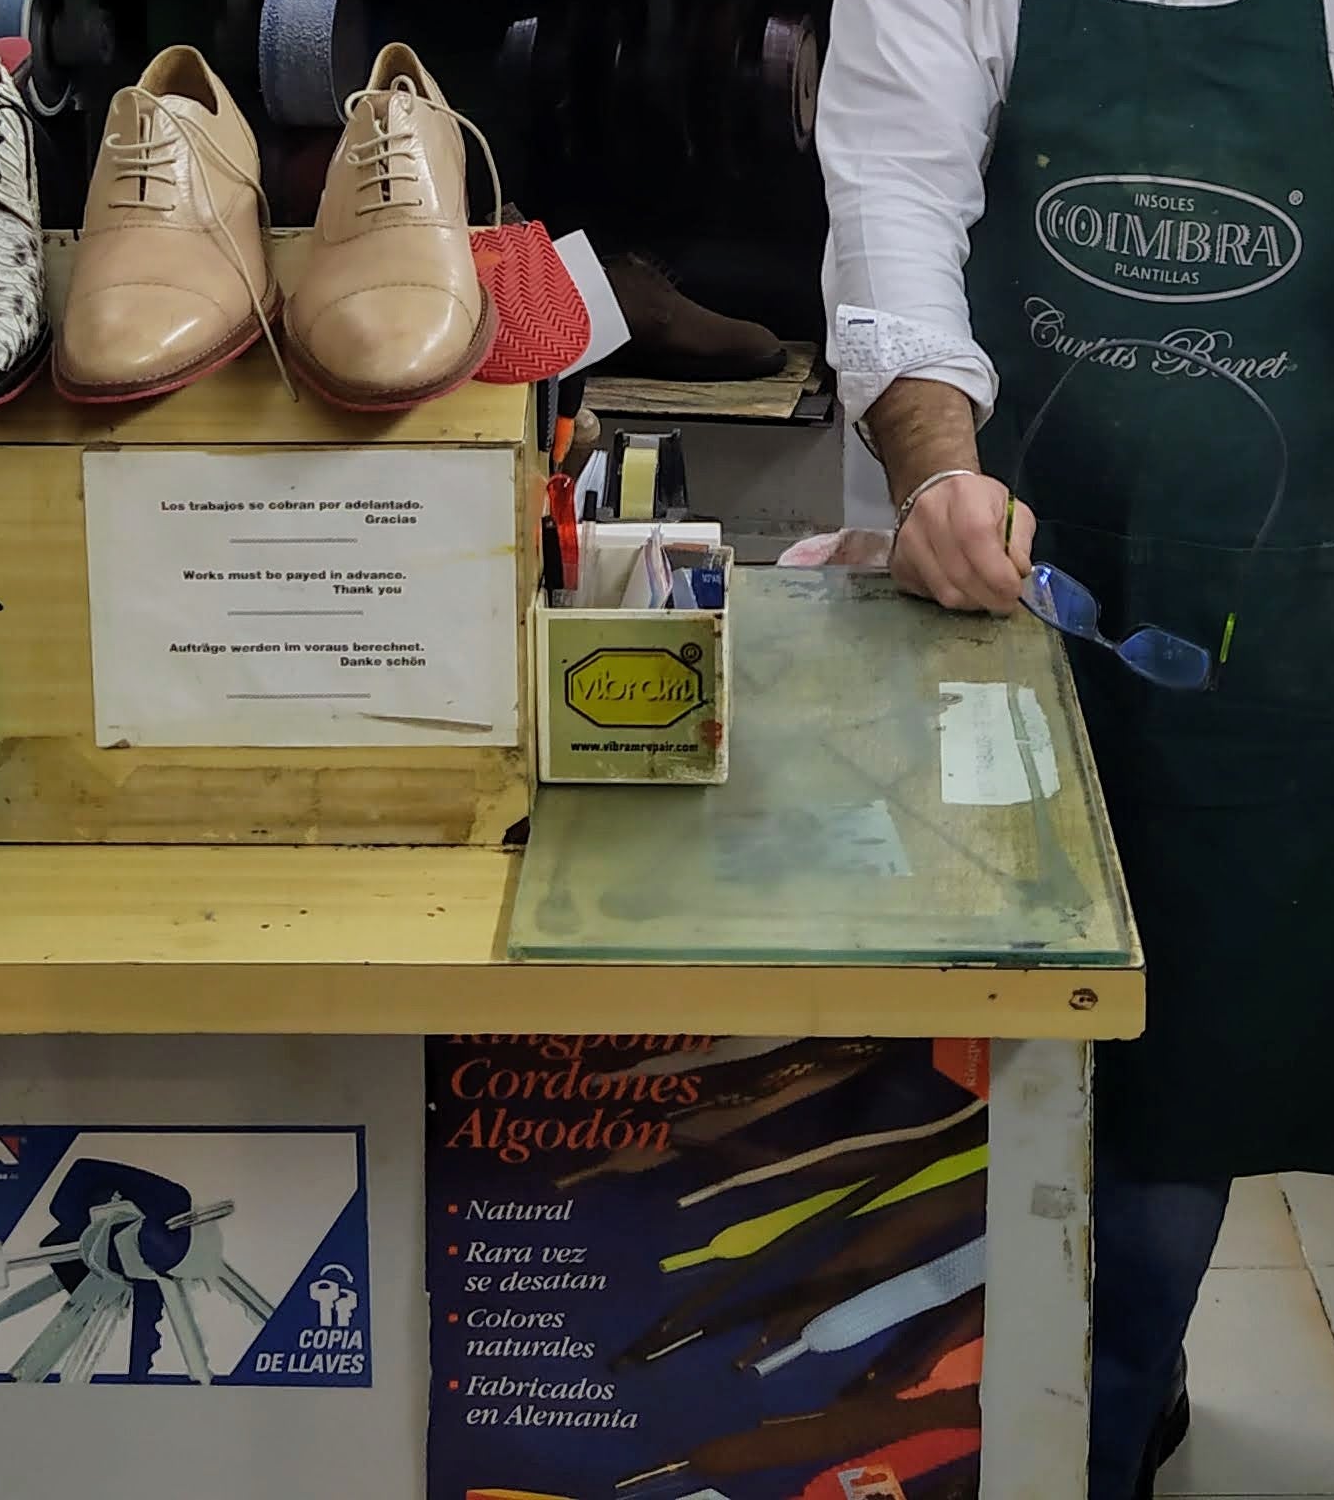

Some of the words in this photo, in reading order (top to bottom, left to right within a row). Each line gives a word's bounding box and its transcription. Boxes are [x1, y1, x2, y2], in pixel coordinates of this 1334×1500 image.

[1134, 192, 1195, 212] INSOLES
[1046, 198, 1283, 267] COIMBRA
[1114, 262, 1200, 285] PLANTILLAS
[161, 501, 185, 513] Los
[189, 501, 245, 515] trabajos
[249, 501, 265, 513] se
[269, 501, 316, 513] cobran
[319, 501, 341, 515] por
[345, 501, 424, 513] adelantado.
[365, 514, 417, 526] Gracias
[183, 570, 224, 581] Works
[228, 570, 262, 581] must
[266, 570, 282, 581] be
[286, 570, 326, 584] payed
[330, 570, 343, 581] in
[346, 570, 407, 581] advance.
[333, 584, 373, 595] Thank
[378, 586, 402, 598] you
[169, 641, 226, 656] Aufträge
[231, 641, 281, 653] werden
[284, 641, 301, 653] im
[304, 641, 349, 653] voraus
[352, 641, 425, 653] berechnet.
[340, 656, 381, 667] Danke
[386, 655, 426, 667] schön
[571, 660, 697, 703] vibram
[570, 739, 699, 755] www.vibramrepair.com
[450, 1059, 702, 1104] Cordones
[445, 1108, 672, 1163] Algodón
[465, 1199, 574, 1223] Natural
[465, 1242, 532, 1266] Rara
[541, 1244, 587, 1266] vez
[465, 1275, 493, 1293] se
[500, 1269, 608, 1293] desatan
[466, 1309, 566, 1330] Colores
[299, 1329, 364, 1351] COPIA
[466, 1337, 596, 1360] naturales
[255, 1353, 284, 1374] DE
[287, 1353, 366, 1376] LLAVES
[466, 1376, 615, 1402] Fabricados
[466, 1409, 500, 1426] en
[504, 1404, 639, 1430] Alemania
